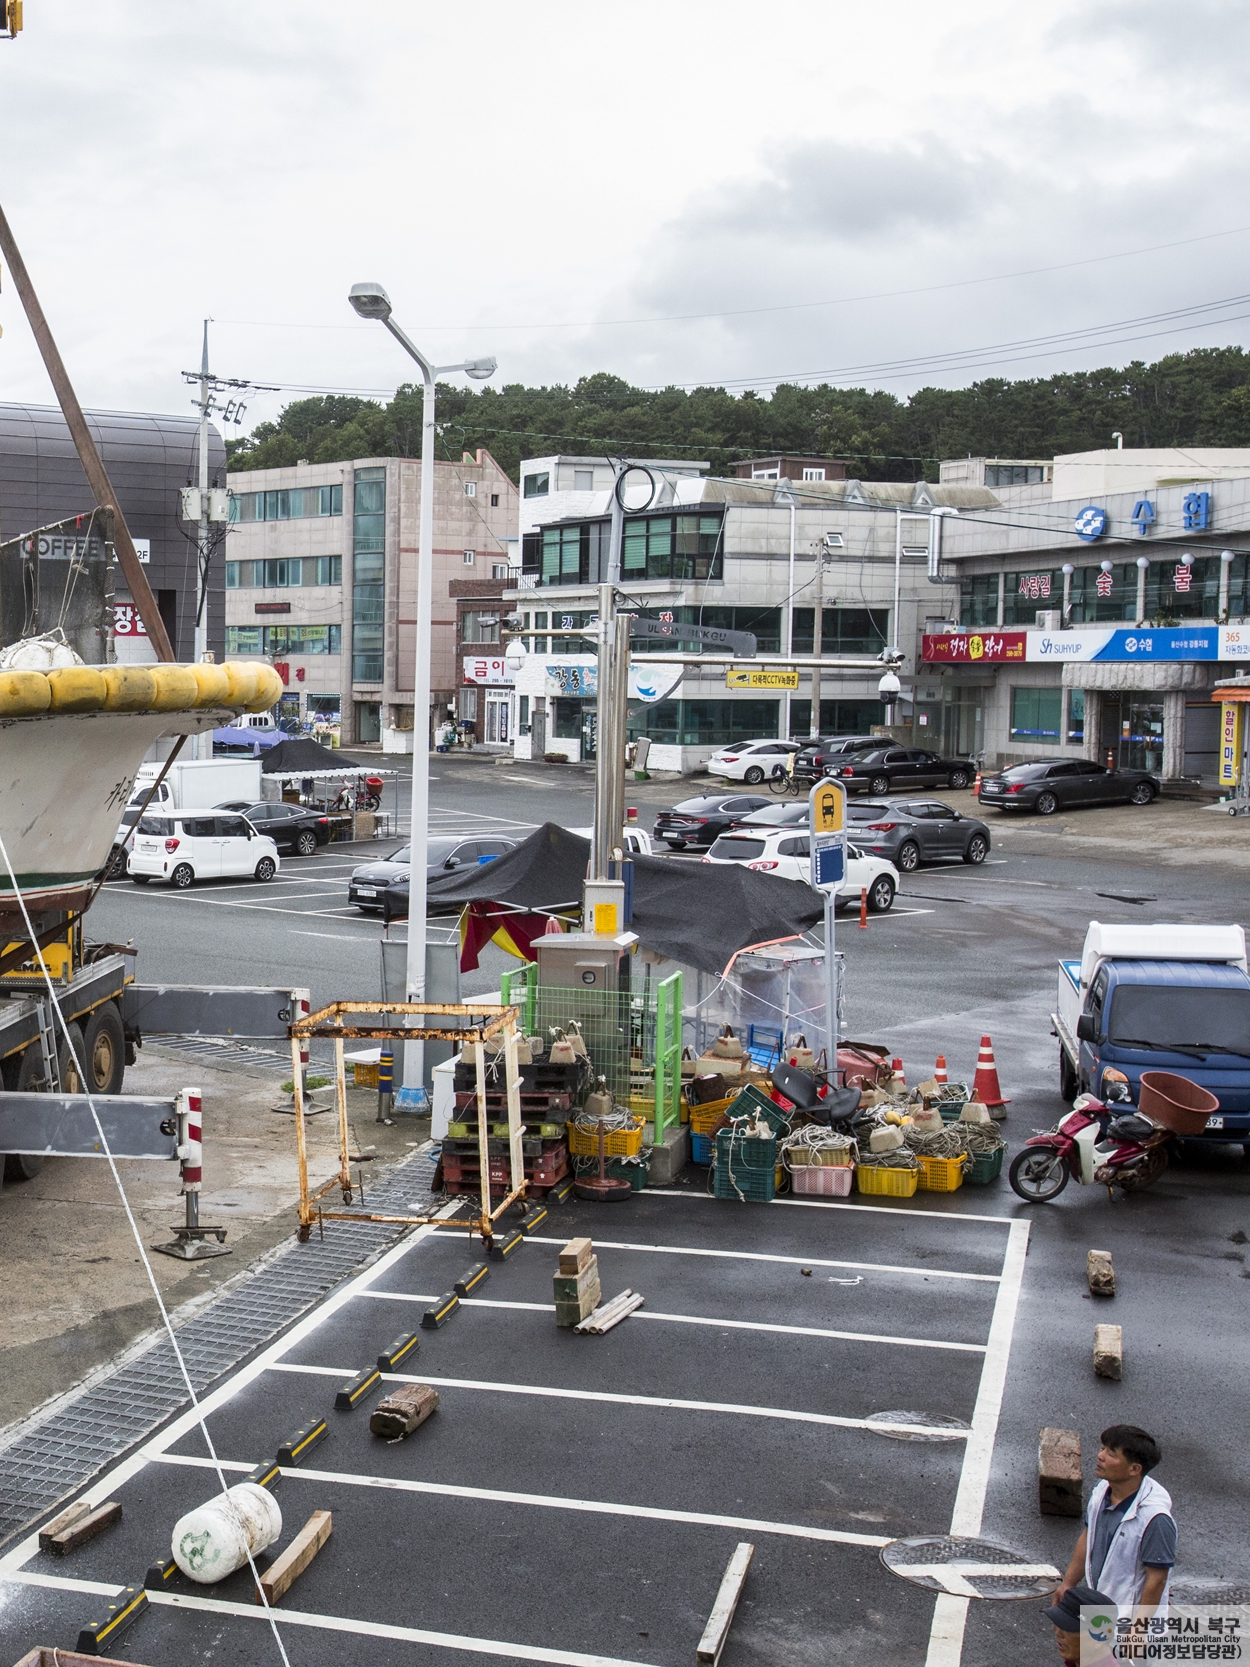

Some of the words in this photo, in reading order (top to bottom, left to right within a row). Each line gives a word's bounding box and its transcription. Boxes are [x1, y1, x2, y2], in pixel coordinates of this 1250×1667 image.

[1131, 492, 1210, 535] 수협
[1019, 575, 1051, 599] 사랑길
[1174, 565, 1192, 592] 불
[648, 624, 682, 636] ULSAN
[1225, 632, 1240, 643] 365
[1039, 638, 1053, 654] Sh
[1054, 643, 1082, 654] SUHYUP
[1138, 638, 1153, 652] 수협
[752, 674, 796, 686] 다목적CCTV녹화중
